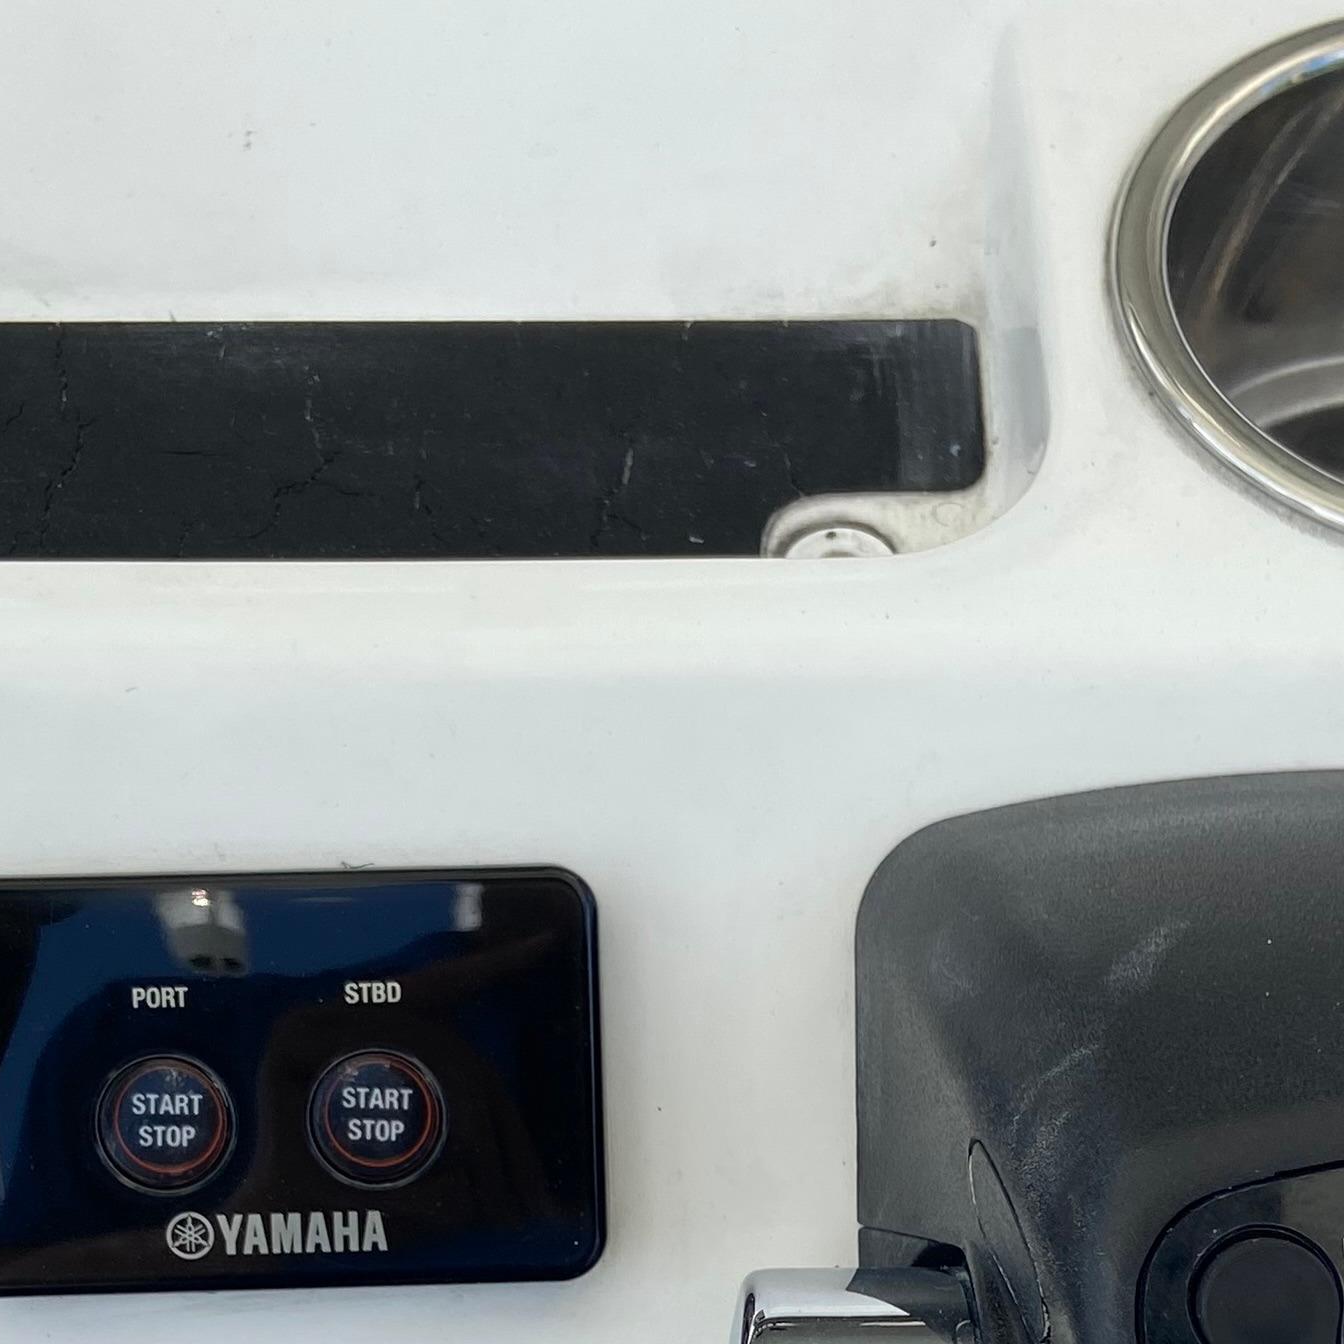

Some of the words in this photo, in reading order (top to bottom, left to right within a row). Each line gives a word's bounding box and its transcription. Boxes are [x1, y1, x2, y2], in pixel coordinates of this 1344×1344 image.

[131, 986, 188, 1008] PORT
[344, 981, 402, 1004] STBD
[132, 1093, 203, 1116] START
[341, 1087, 413, 1111] START
[138, 1125, 197, 1148] STOP
[347, 1119, 405, 1142] STOP
[216, 1210, 389, 1256] YAMAHA
